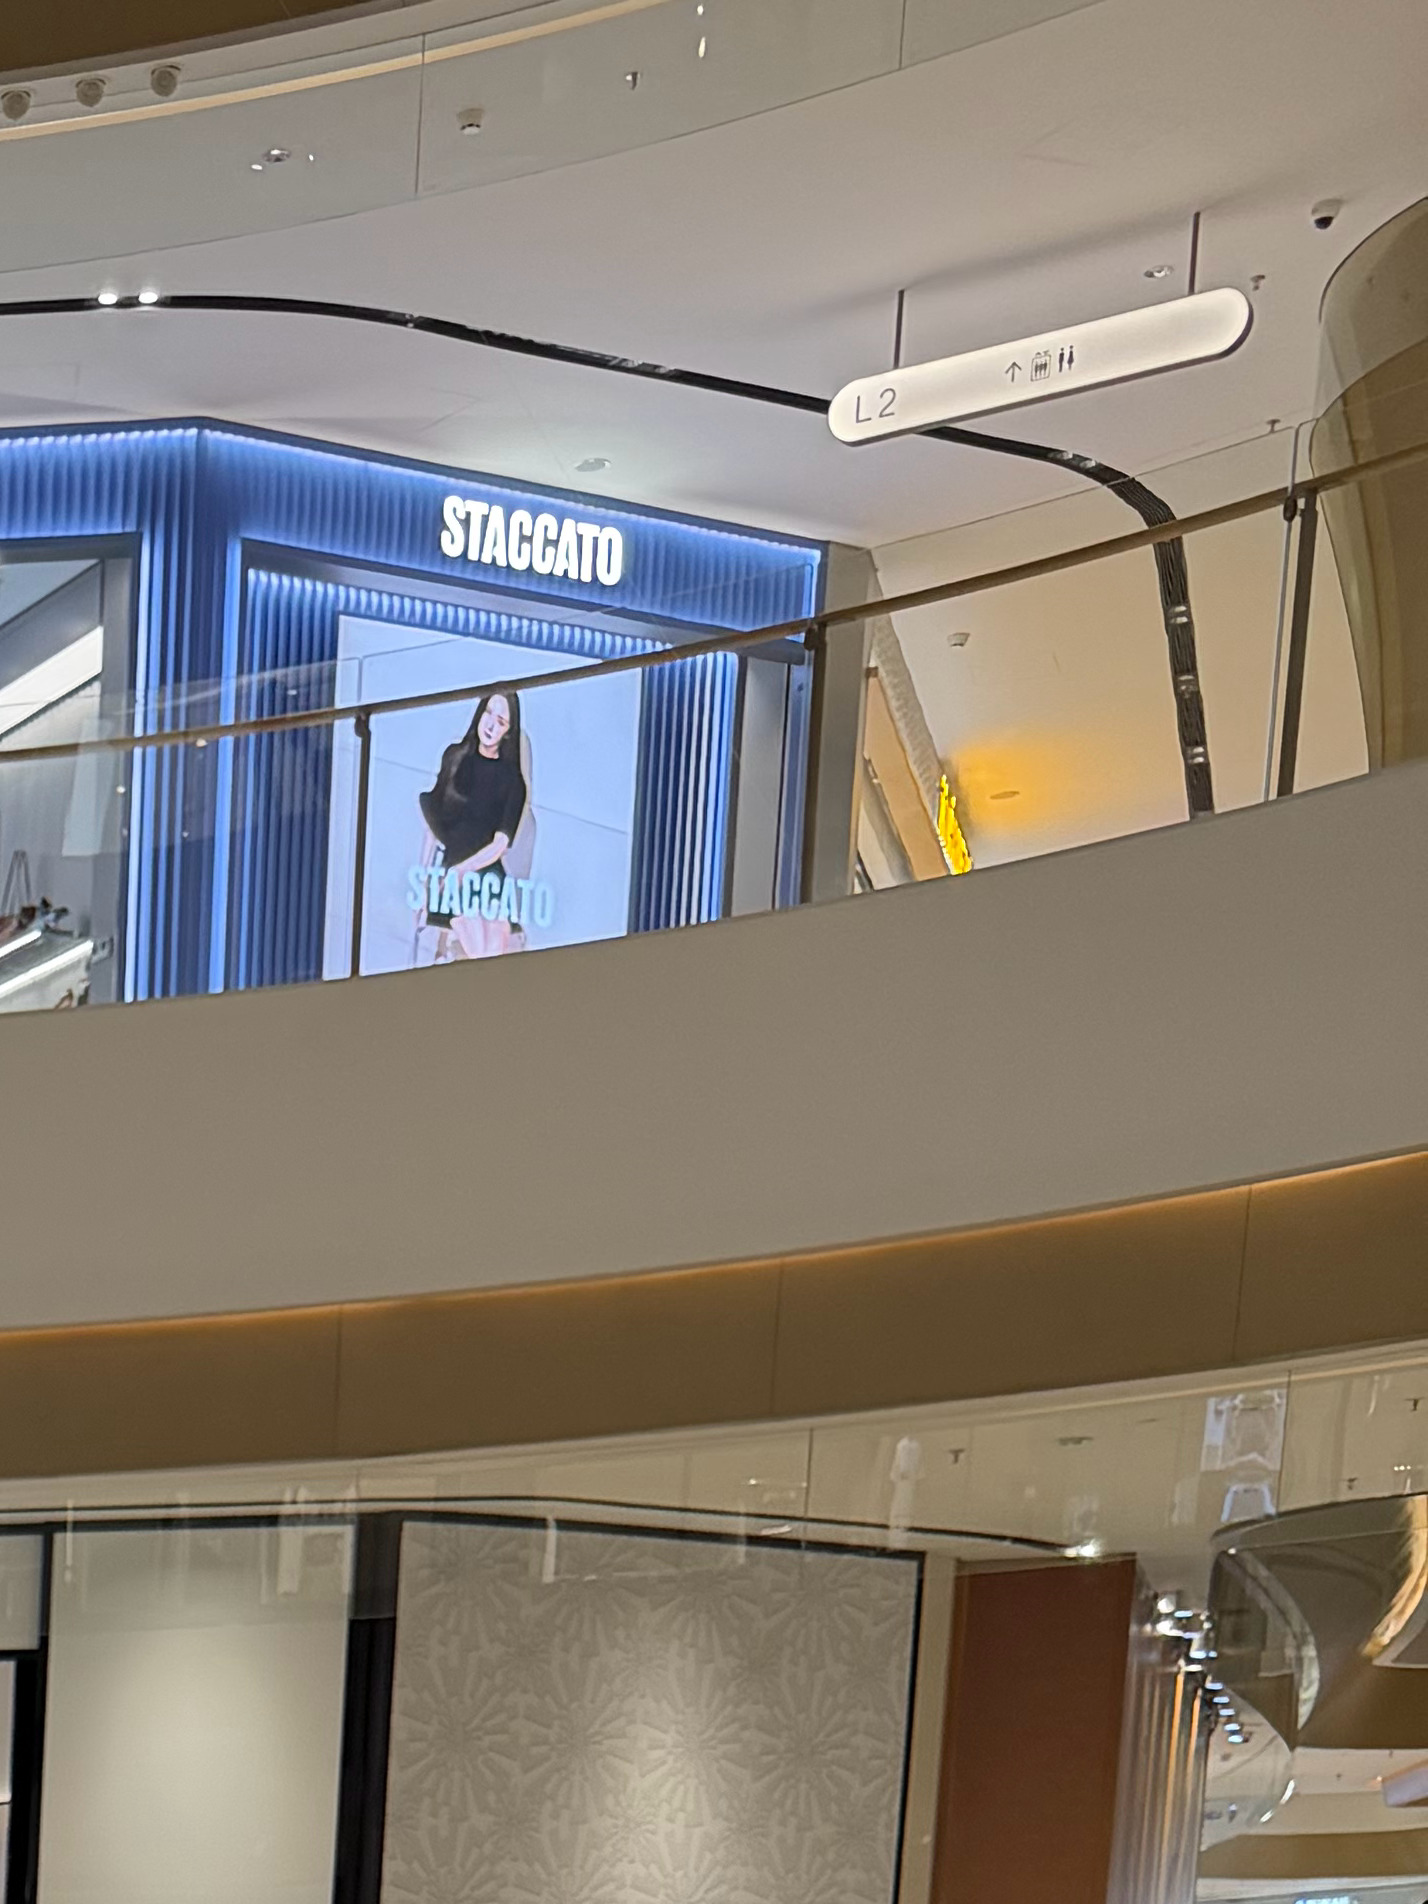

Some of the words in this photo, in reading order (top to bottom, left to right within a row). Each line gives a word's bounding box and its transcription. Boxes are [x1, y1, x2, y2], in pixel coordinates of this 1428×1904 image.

[854, 387, 897, 425] L2
[441, 495, 625, 586] STACCATO
[406, 864, 555, 928] STACCATO
